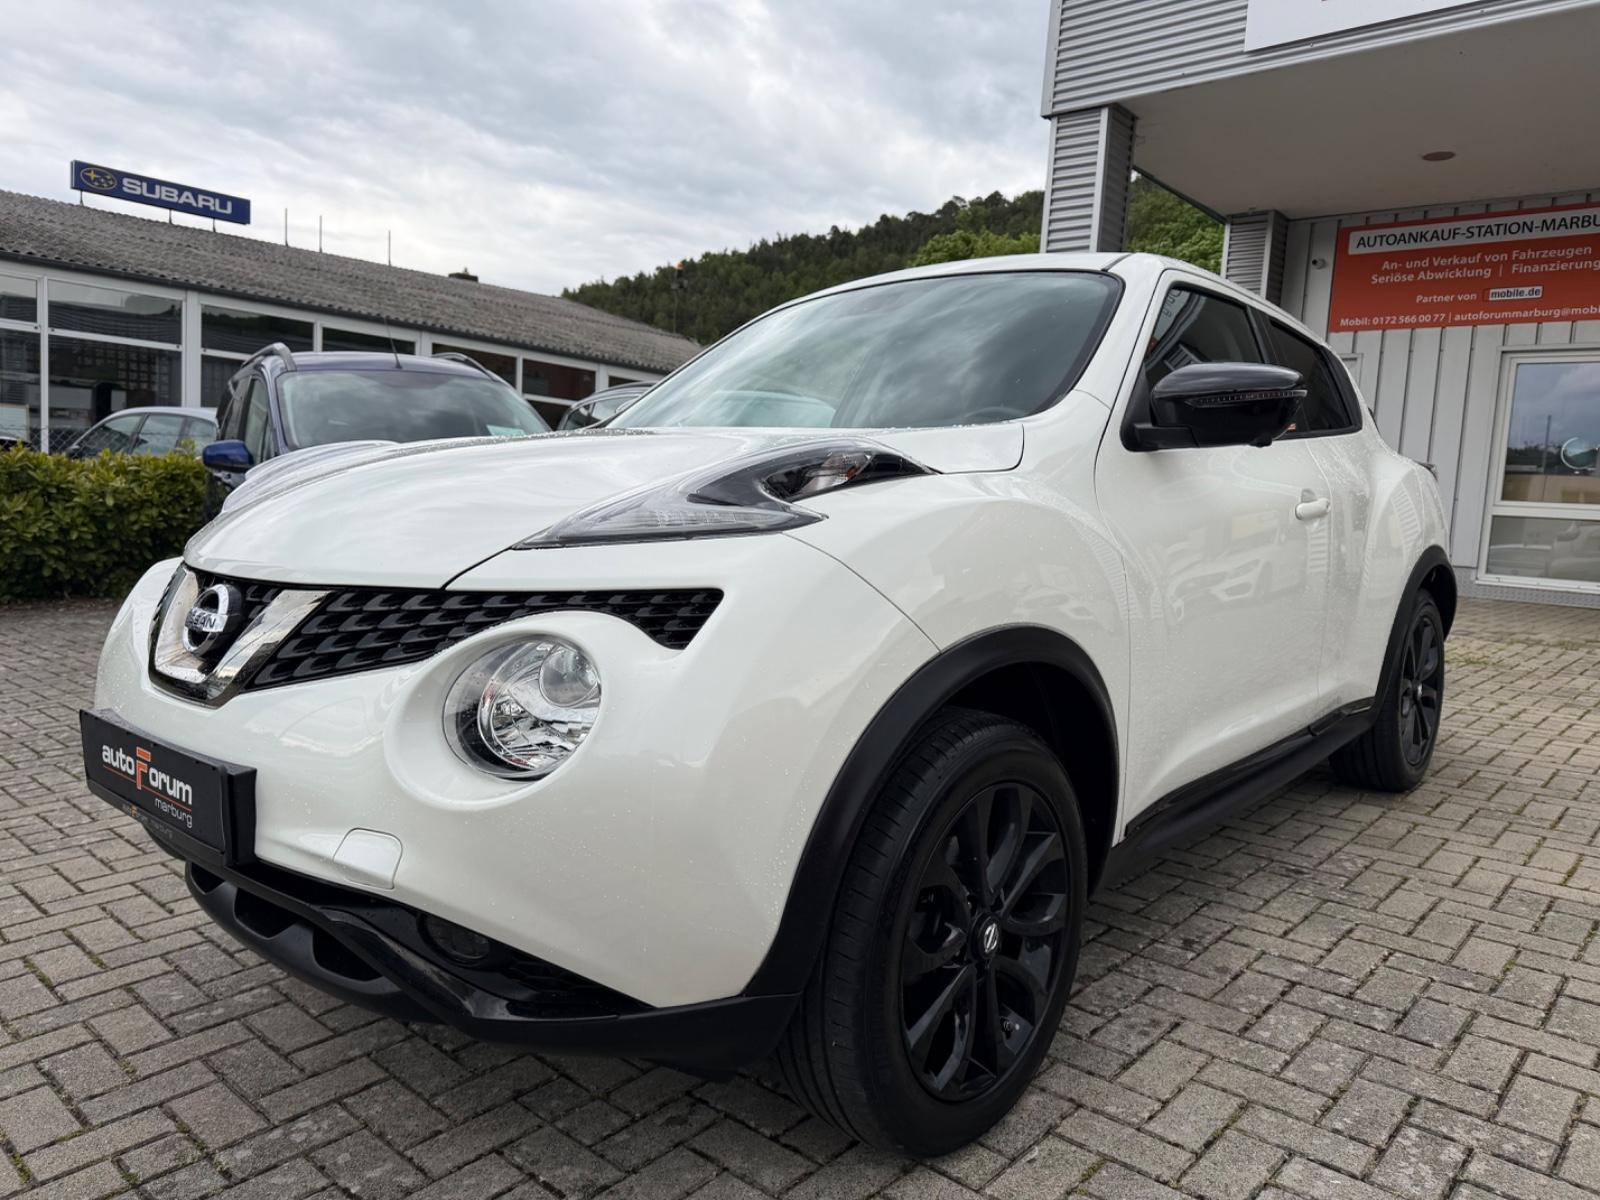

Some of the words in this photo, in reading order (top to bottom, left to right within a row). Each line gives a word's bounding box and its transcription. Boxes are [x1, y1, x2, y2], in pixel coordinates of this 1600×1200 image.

[122, 177, 232, 214] SUBARU
[1356, 213, 1600, 249] AUTOANKAUF-STATION-MARBU
[1382, 260, 1402, 271] An-
[1406, 257, 1429, 269] und
[1432, 252, 1484, 266] Verkauf
[1485, 253, 1508, 263] von
[1512, 246, 1592, 260] Fahrzeugen
[1371, 273, 1415, 285] Seriöse
[1417, 267, 1492, 280] Abwicklung
[1512, 259, 1600, 274] Finanzierung
[1416, 294, 1455, 303] Partner
[1457, 293, 1477, 301] von
[1490, 288, 1541, 298] mobile.de
[1340, 317, 1371, 326] Mobil:
[1372, 316, 1397, 325] 0172
[1399, 314, 1417, 324] 566
[1419, 314, 1431, 323] 00
[1433, 313, 1446, 321] 77
[154, 798, 192, 828] marburg
